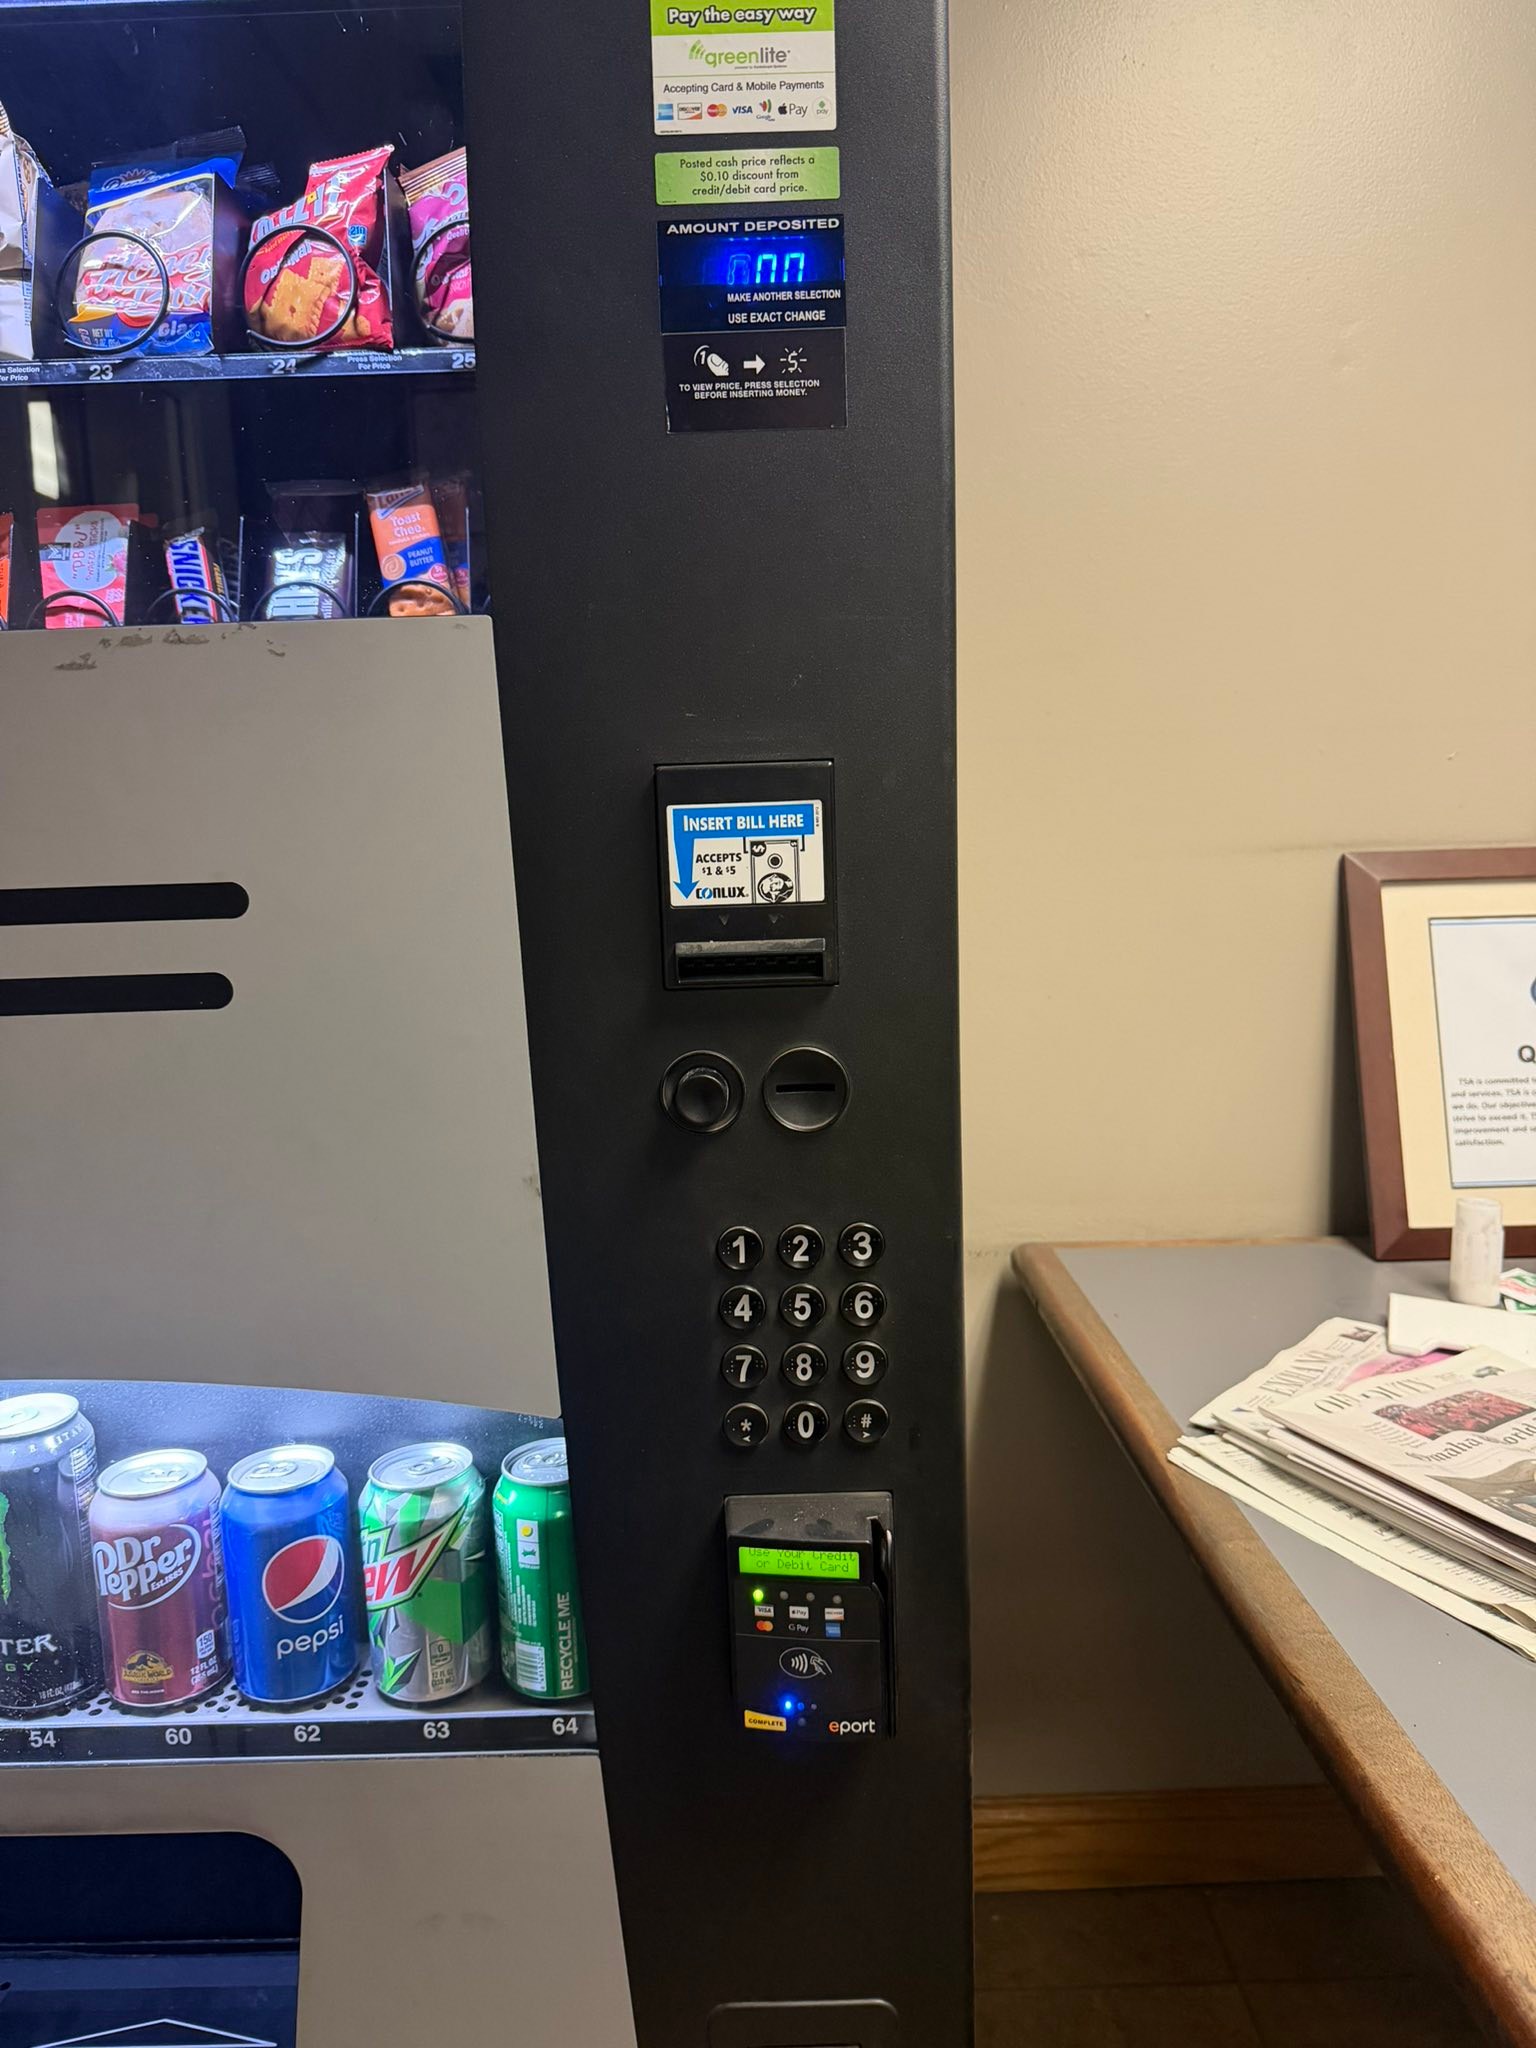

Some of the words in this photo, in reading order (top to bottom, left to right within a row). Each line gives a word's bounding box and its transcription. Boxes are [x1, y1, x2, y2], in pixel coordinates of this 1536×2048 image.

[668, 8, 701, 27] Pay
[705, 6, 731, 22] the
[734, 9, 774, 25] easy
[779, 7, 816, 23] way
[705, 47, 788, 68] greenlite
[663, 83, 709, 94] Accepting
[711, 82, 734, 92] Card
[736, 82, 743, 91] &
[746, 81, 777, 91] Mobile
[779, 80, 824, 91] Payments
[732, 106, 753, 114] VISA
[789, 103, 808, 116] Pay
[680, 158, 712, 168] Posted
[716, 157, 738, 167] cash
[741, 157, 767, 169] price
[769, 155, 805, 166] reflects
[700, 171, 729, 182] $0.10
[732, 170, 773, 180] discount
[776, 169, 799, 179] from
[692, 184, 750, 196] credit/debit
[754, 184, 776, 193] card
[779, 183, 808, 196] price.
[667, 222, 739, 235] AMOUNT
[744, 218, 840, 232] DEPOSITED
[727, 292, 751, 302] MAKE
[753, 291, 793, 301] ANOTHER
[794, 289, 841, 300] SELECTION
[728, 313, 748, 324] USE
[750, 311, 782, 323] EXACT
[784, 310, 826, 321] CHANGE
[369, 354, 403, 362] Selection
[452, 354, 476, 369] 25
[89, 365, 114, 381] 23
[272, 358, 297, 374] 24
[679, 384, 691, 392] TO
[693, 383, 713, 392] VIEW
[744, 381, 772, 389] PRESS
[774, 379, 820, 388] SELECTION
[694, 391, 728, 400] BEFORE
[729, 389, 774, 399] INSERTING
[776, 388, 807, 397] MONEY.
[391, 512, 421, 526] Toast
[407, 547, 433, 558] PEANUT
[409, 556, 434, 567] BUTTER
[683, 815, 734, 832] INSERT
[736, 814, 765, 830] BILL
[769, 813, 804, 829] HERE
[696, 853, 742, 864] ACCEPTS
[702, 866, 713, 876] $1
[715, 866, 723, 876] &
[725, 865, 736, 875] $5
[1484, 1077, 1529, 1085] committed
[1454, 1127, 1510, 1135] improvement
[732, 1235, 746, 1264] 1
[792, 1234, 809, 1262] 2
[853, 1231, 873, 1260] 3
[734, 1294, 752, 1322] 4
[794, 1293, 811, 1321] 5
[854, 1290, 874, 1319] 6
[735, 1354, 752, 1382] 7
[796, 1353, 812, 1381] 8
[855, 1350, 875, 1378] 9
[798, 1411, 815, 1439] 0
[860, 1413, 872, 1428] #
[113, 1535, 161, 1572] Dr
[749, 1548, 770, 1557] Use
[756, 1560, 769, 1568] or
[777, 1560, 813, 1570] Debit
[820, 1561, 849, 1572] Card
[557, 1592, 570, 1618] ME
[797, 1624, 809, 1633] Pay
[277, 1614, 345, 1660] pepsi
[558, 1620, 575, 1691] RECYCLE
[423, 1721, 451, 1739] 63
[552, 1717, 579, 1735] 64
[748, 1718, 784, 1728] COMPLETE
[829, 1719, 876, 1734] eport
[30, 1730, 57, 1748] 54
[165, 1728, 192, 1746] 60
[294, 1725, 321, 1742] 62
